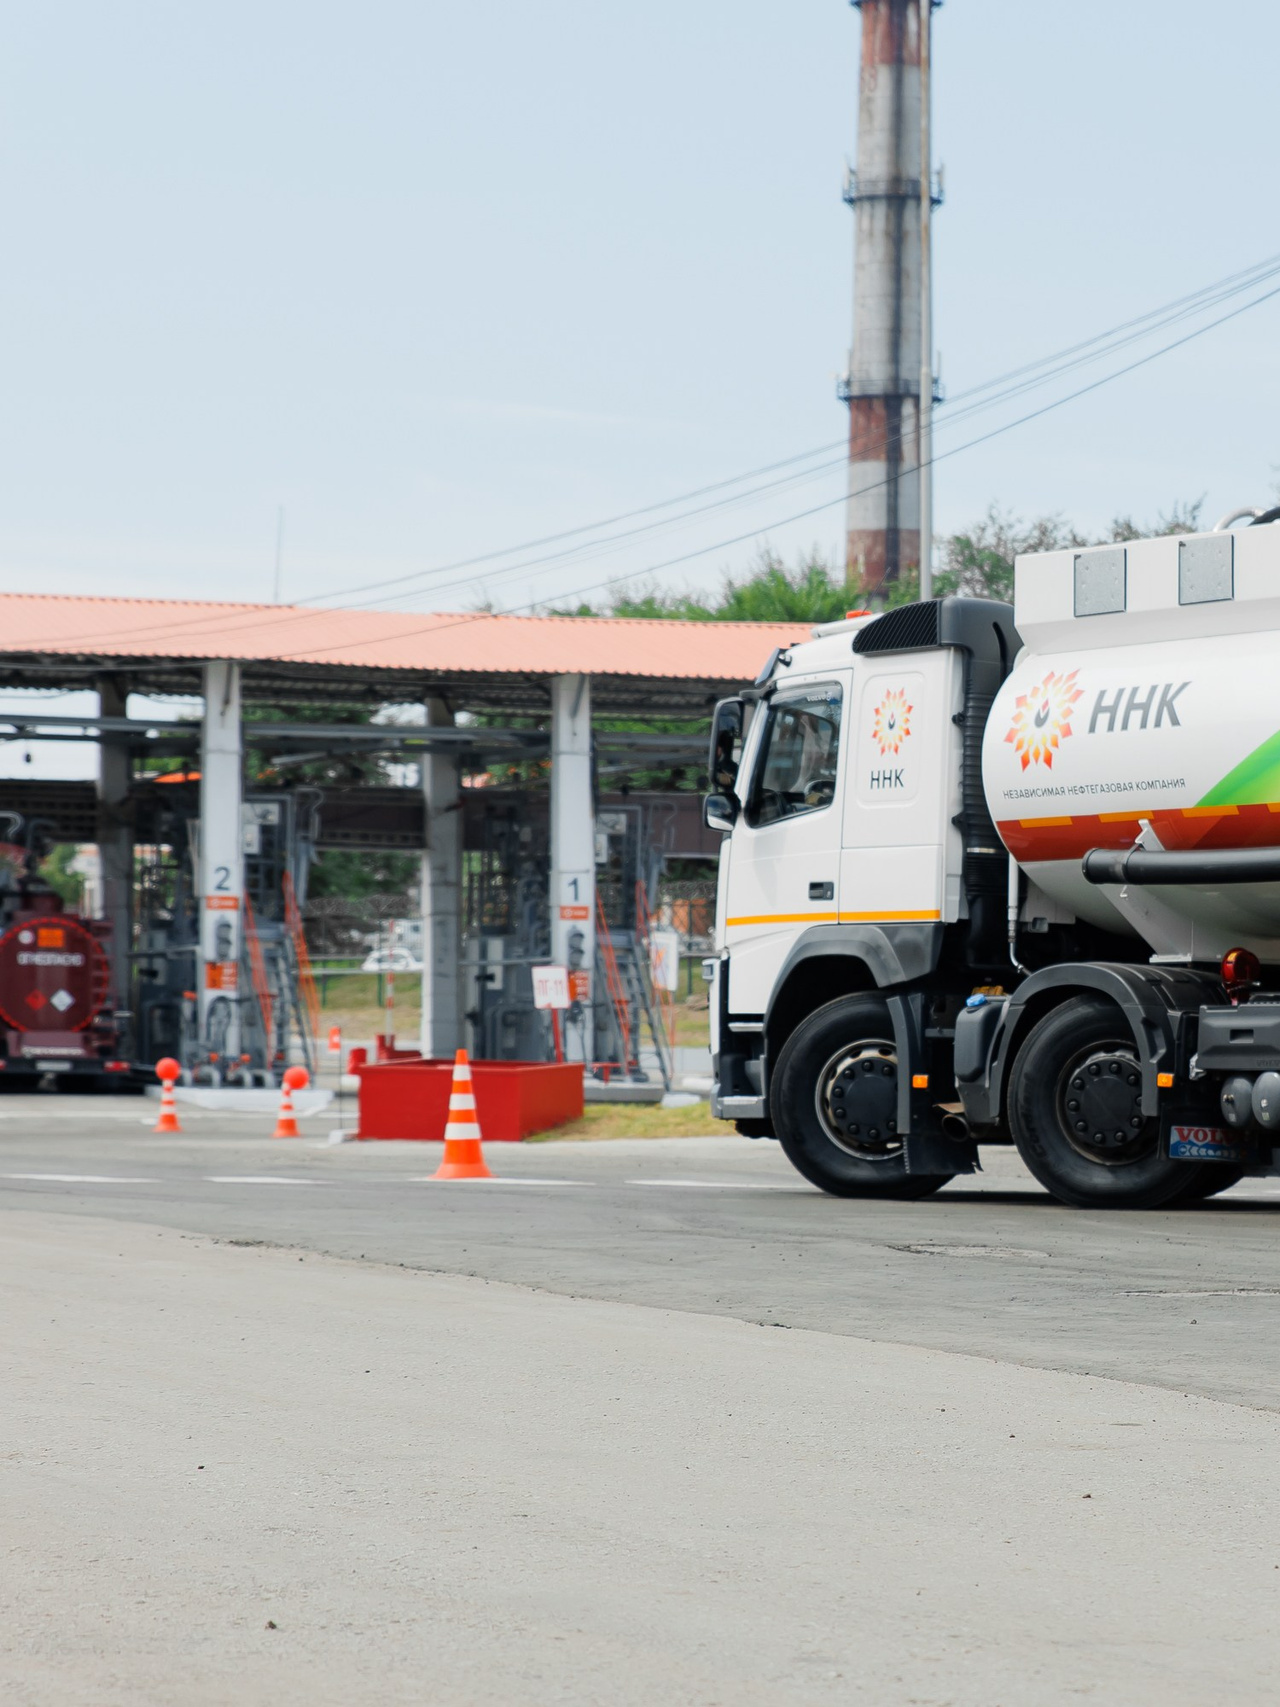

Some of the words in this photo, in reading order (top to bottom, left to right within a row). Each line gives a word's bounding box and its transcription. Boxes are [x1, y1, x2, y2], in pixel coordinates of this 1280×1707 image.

[1087, 680, 1193, 735] ННК
[870, 768, 905, 790] ННК
[1003, 786, 1066, 800] НЕЗАВИСИМАЯ
[1068, 781, 1134, 796] НЕФТЕГАЗОВАЯ
[1136, 778, 1186, 791] КОМПАНИЯ
[214, 866, 230, 891] 2
[568, 877, 579, 902] 1
